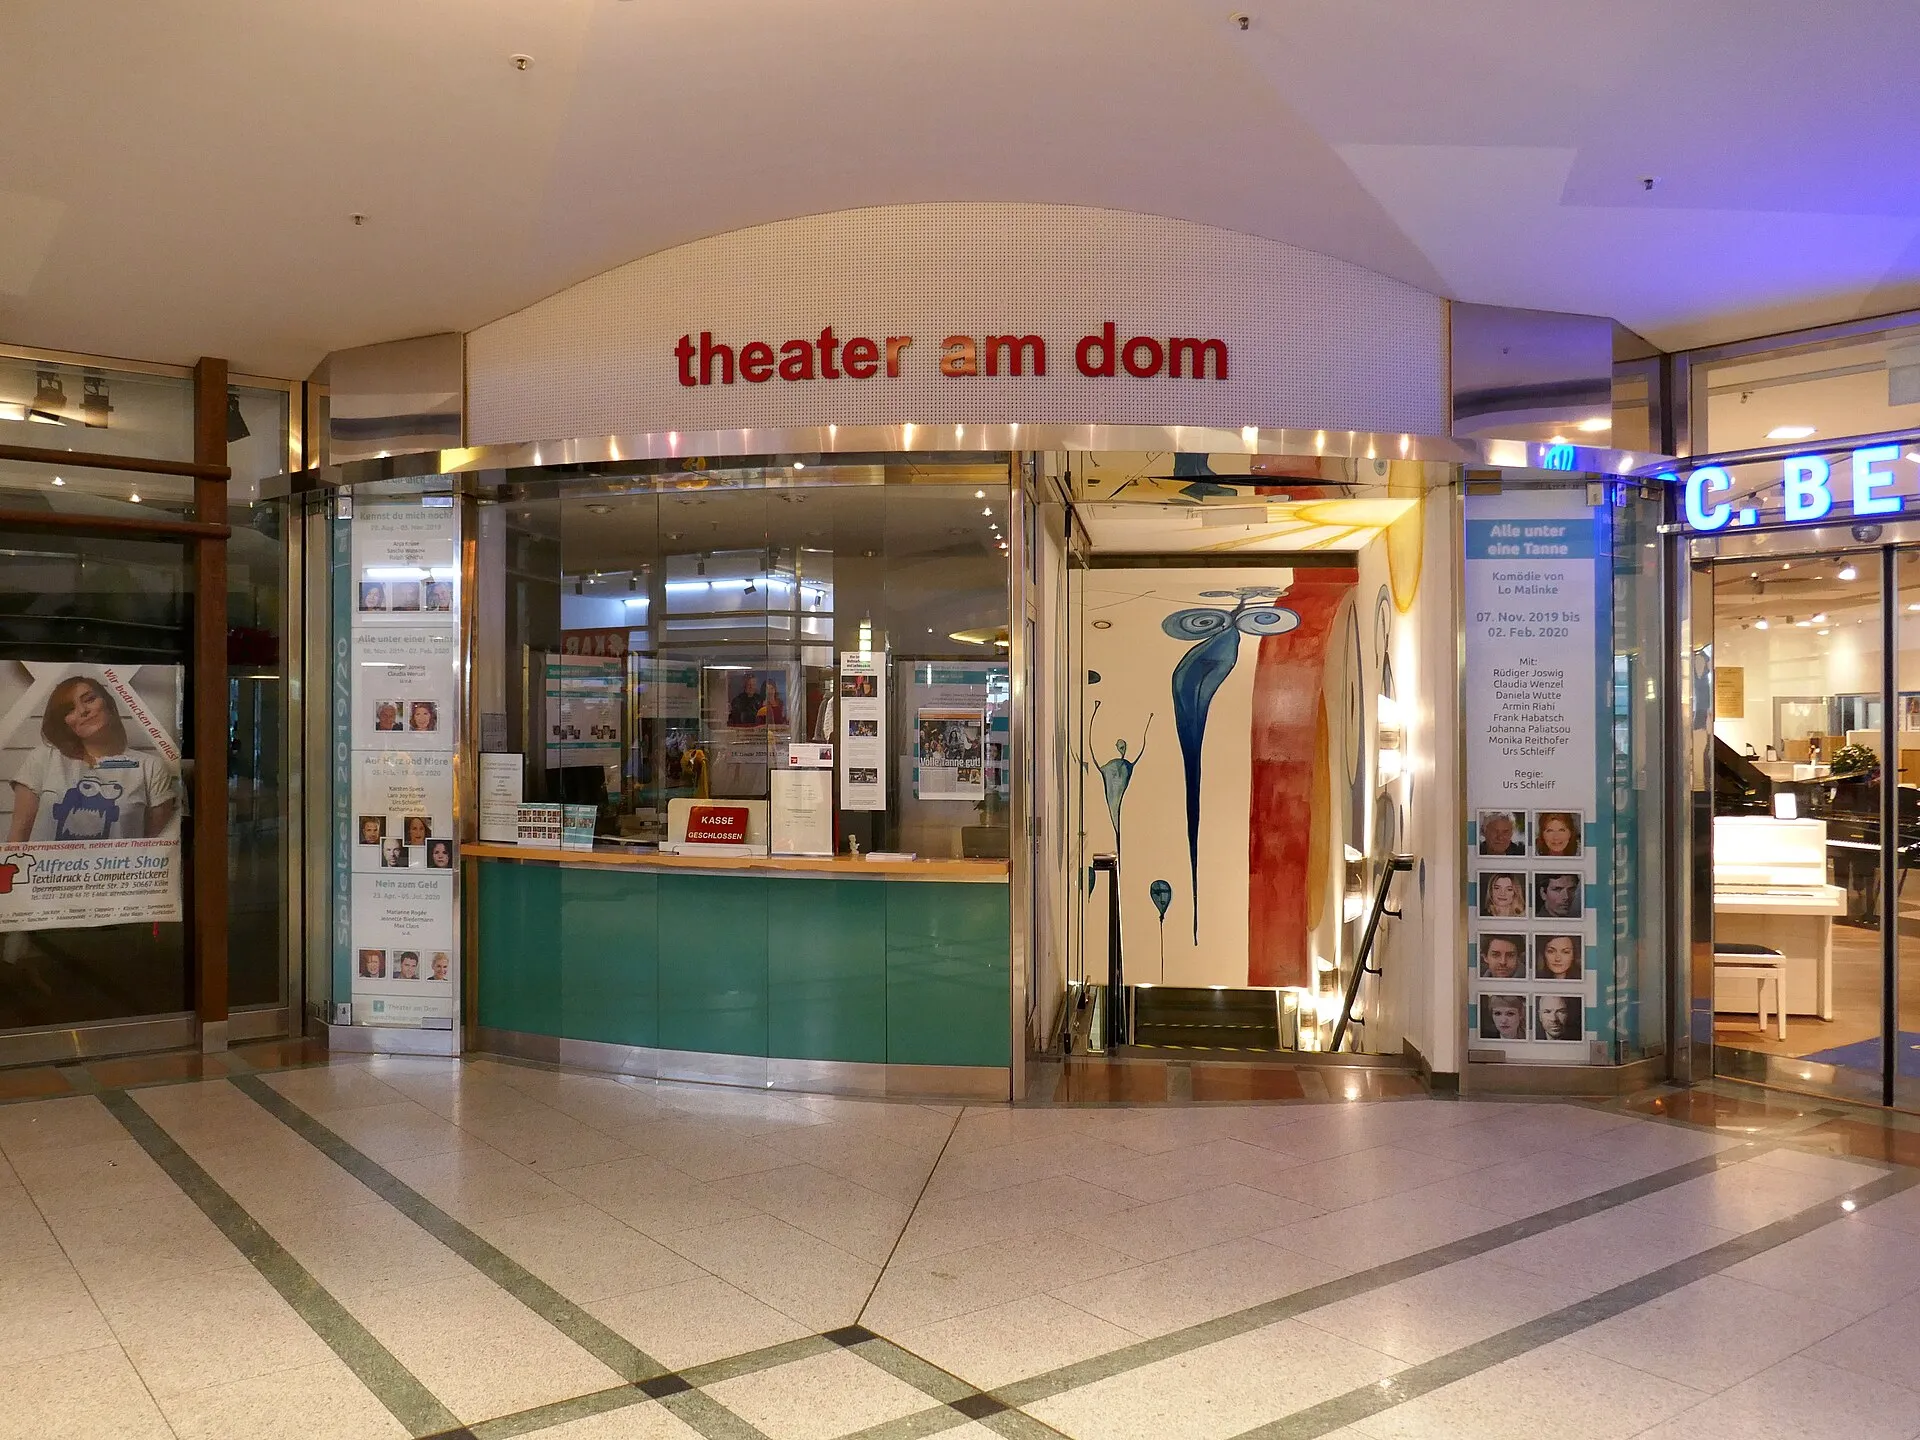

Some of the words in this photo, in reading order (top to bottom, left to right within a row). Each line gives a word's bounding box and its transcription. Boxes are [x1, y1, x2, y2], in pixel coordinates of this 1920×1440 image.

[674, 325, 913, 387] theater
[940, 334, 1046, 378] am
[1075, 321, 1228, 380] dom
[1684, 465, 1757, 531] C.
[360, 511, 390, 520] Kennst
[392, 511, 403, 520] du
[405, 510, 426, 520] mich
[1490, 523, 1520, 537] Alle
[1524, 525, 1566, 537] unter
[1488, 542, 1520, 555] eine
[1524, 542, 1568, 555] Tanne
[1492, 571, 1541, 581] Komödie
[1544, 573, 1564, 581] von
[1498, 585, 1511, 595] Lo
[1514, 585, 1558, 595] Malinke
[1476, 612, 1494, 622] 07.
[1498, 612, 1525, 622] Nov.
[1529, 612, 1559, 622] 2019
[1562, 611, 1580, 622] bis
[1488, 627, 1506, 637] 02.
[1510, 626, 1535, 637] Feb.
[1539, 627, 1569, 637] 2020
[358, 635, 376, 643] Alle
[378, 635, 401, 643] unter
[1519, 658, 1538, 666] Mit:
[1493, 669, 1529, 679] Rüdiger
[1531, 669, 1564, 679] Joswig
[1493, 680, 1528, 688] Claudia
[1530, 680, 1564, 688] Wenzel
[1496, 691, 1530, 700] Daniela
[1533, 691, 1561, 700] Wutte
[104, 668, 118, 683] Wir
[115, 684, 151, 727] bedrucken
[149, 727, 162, 739] dir
[1502, 702, 1530, 711] Armin
[1532, 702, 1555, 711] Riahi
[336, 637, 349, 784] 2019/20
[1493, 713, 1519, 722] Frank
[1521, 713, 1564, 722] Habatsch
[1486, 725, 1526, 733] Johanna
[1528, 725, 1571, 733] Paliatsou
[1489, 736, 1522, 745] Monika
[1525, 736, 1569, 745] Reithofer
[1502, 747, 1518, 756] Urs
[1520, 747, 1556, 756] Schleiff
[920, 757, 939, 768] Volle
[941, 757, 964, 768] Tanne
[965, 757, 981, 769] gut!
[1514, 769, 1544, 780] Regie:
[1502, 781, 1518, 789] Urs
[1520, 781, 1556, 789] Schleiff
[701, 816, 734, 825] KASSE
[688, 831, 743, 840] GESCHLOSSEN
[35, 858, 90, 874] Alfreds
[94, 856, 131, 870] Shirt
[135, 855, 170, 870] Shop
[337, 793, 349, 947] Spielzeit
[33, 873, 82, 884] Textildruck
[84, 872, 91, 882] &
[93, 868, 169, 882] Computerstickerei
[375, 880, 395, 888] Nein
[397, 881, 415, 889] zum
[418, 880, 438, 889] Geld
[1606, 955, 1630, 1037] Alle
